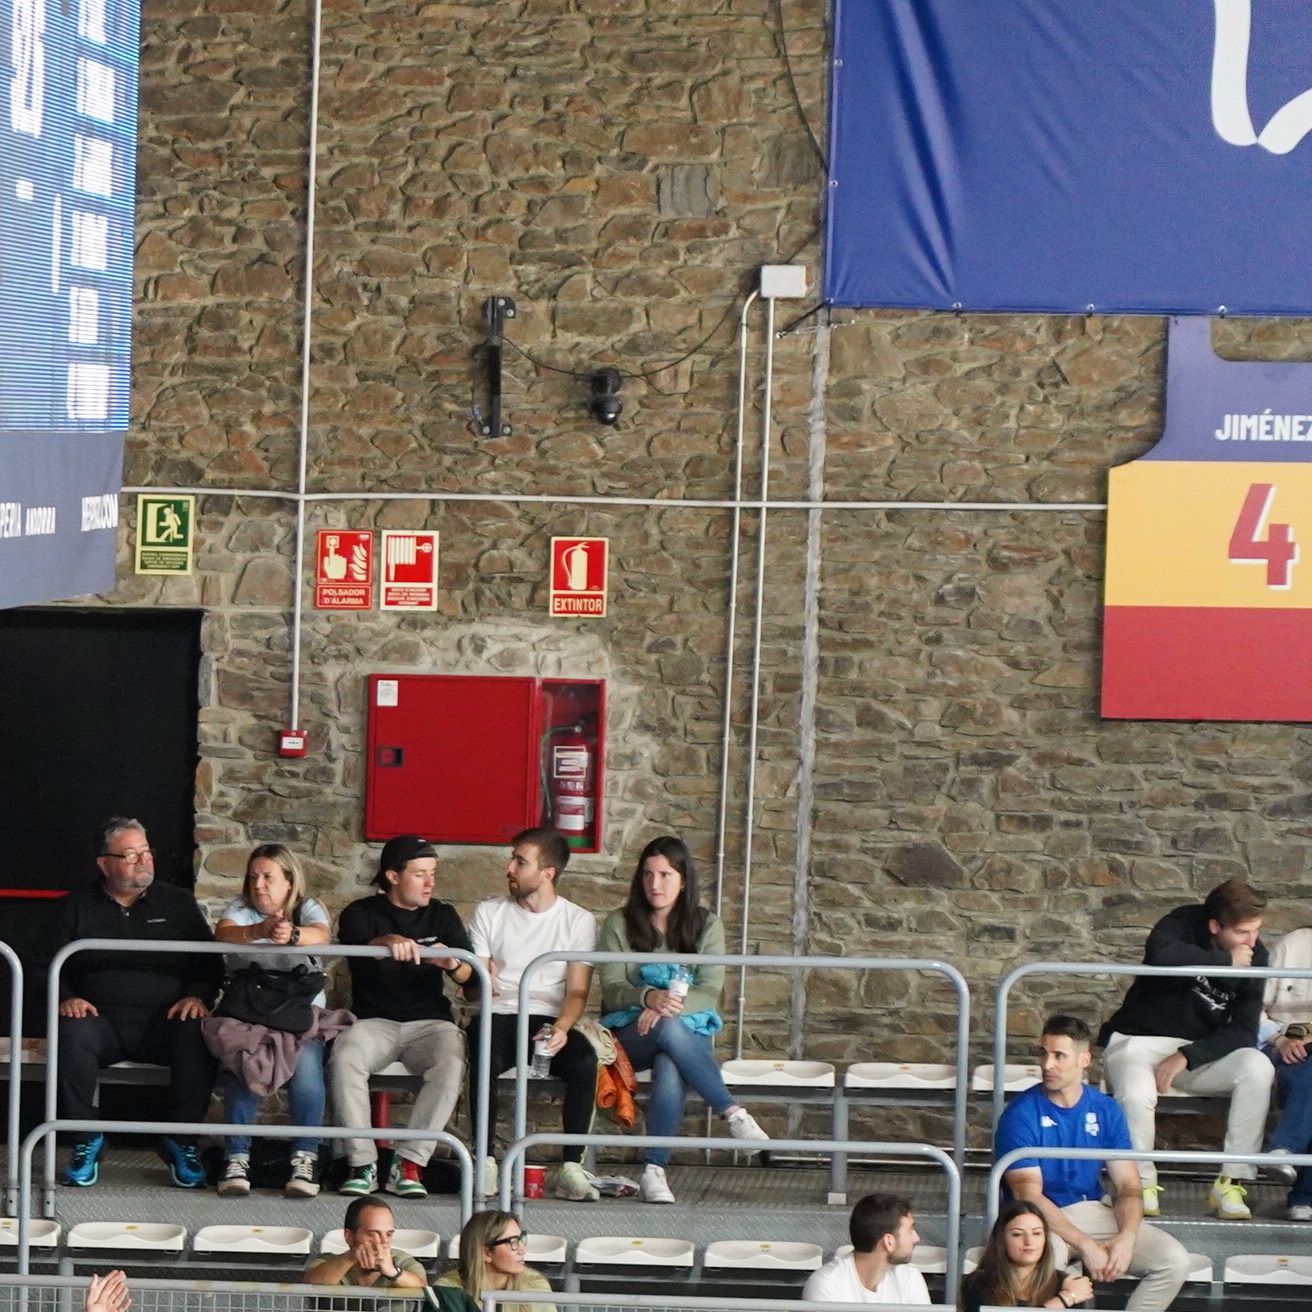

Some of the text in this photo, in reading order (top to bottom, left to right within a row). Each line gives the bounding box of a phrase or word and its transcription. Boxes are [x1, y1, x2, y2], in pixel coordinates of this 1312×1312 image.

[1228, 482, 1300, 591] 4
[322, 588, 366, 597] POLSADOR
[322, 596, 364, 605] D'ALARMA
[554, 597, 603, 613] EXTINTOR
